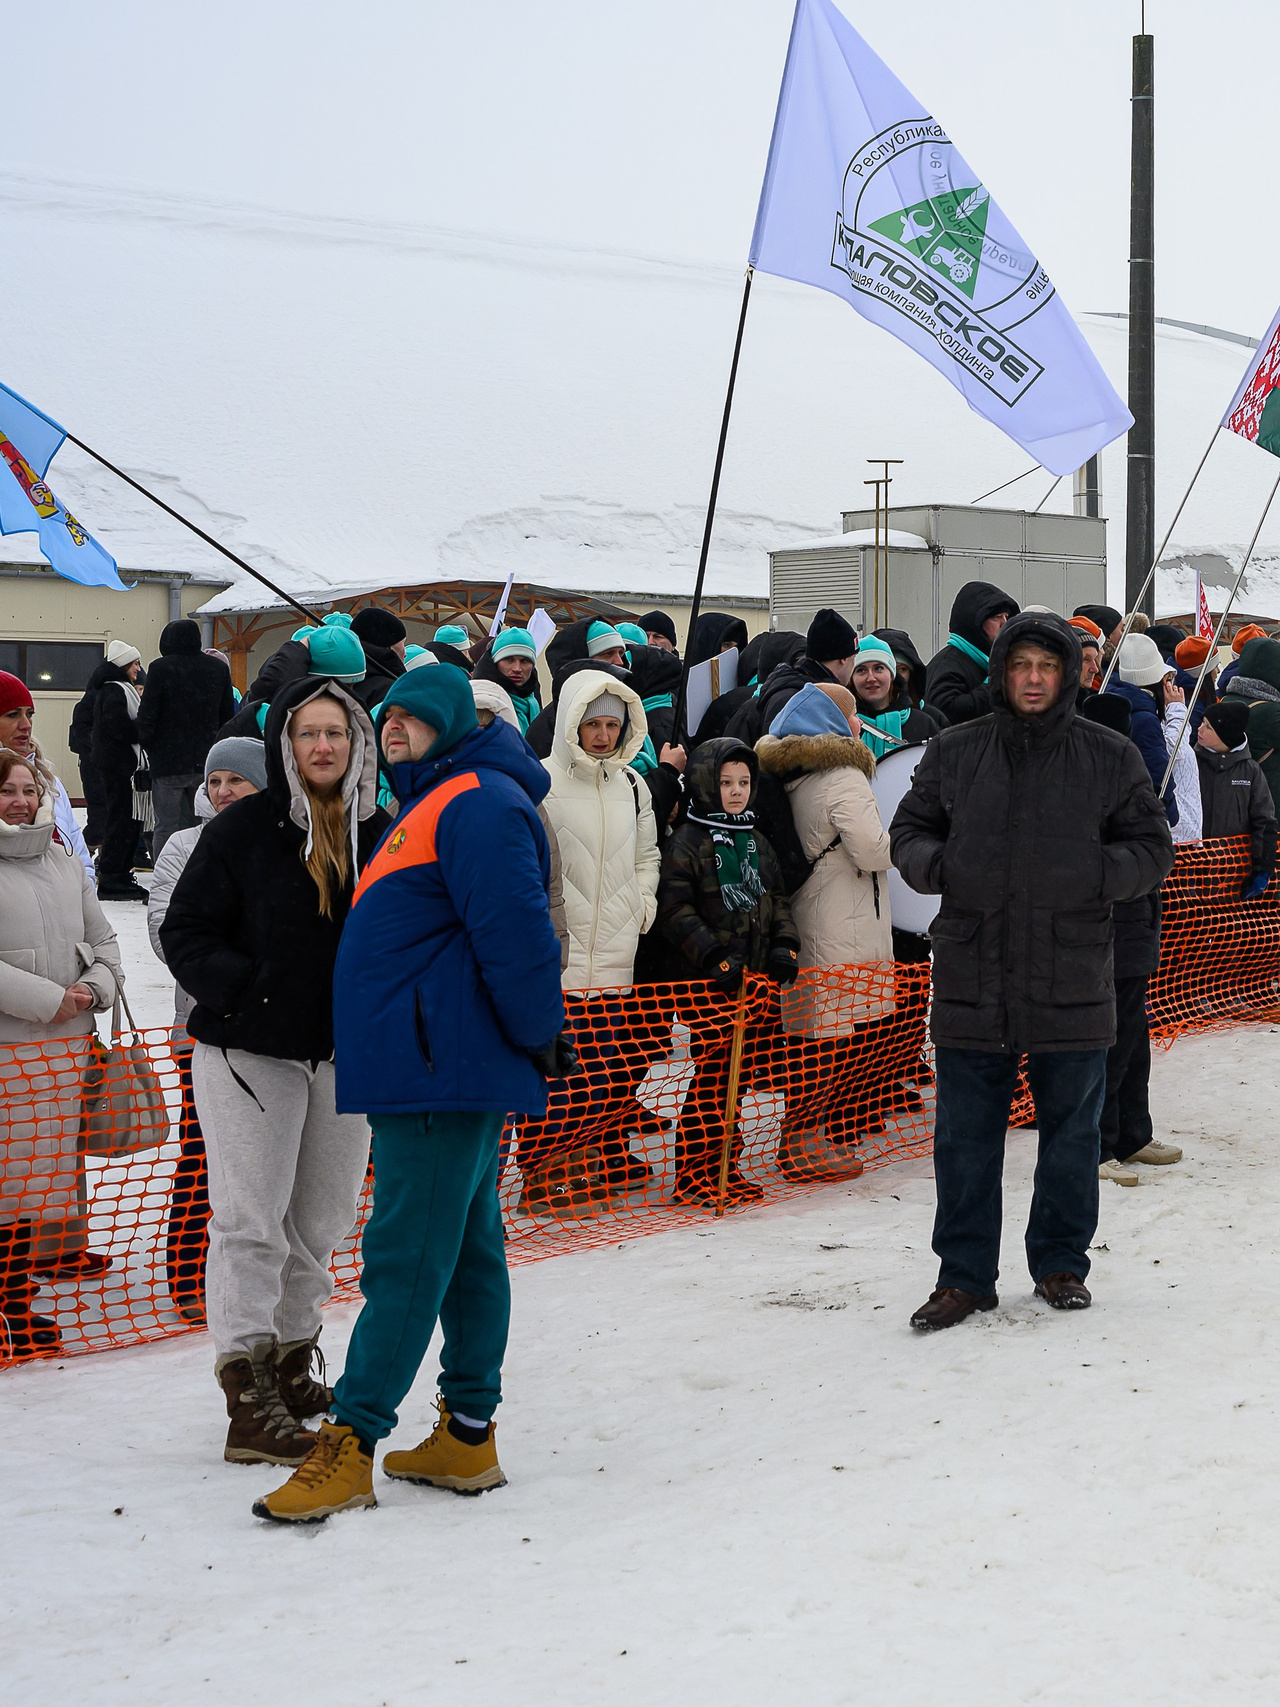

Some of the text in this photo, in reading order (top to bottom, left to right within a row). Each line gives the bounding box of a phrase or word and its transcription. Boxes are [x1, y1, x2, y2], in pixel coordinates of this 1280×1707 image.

[851, 124, 946, 178] Республика
[873, 280, 937, 331] компания
[936, 327, 996, 381] холдинга
